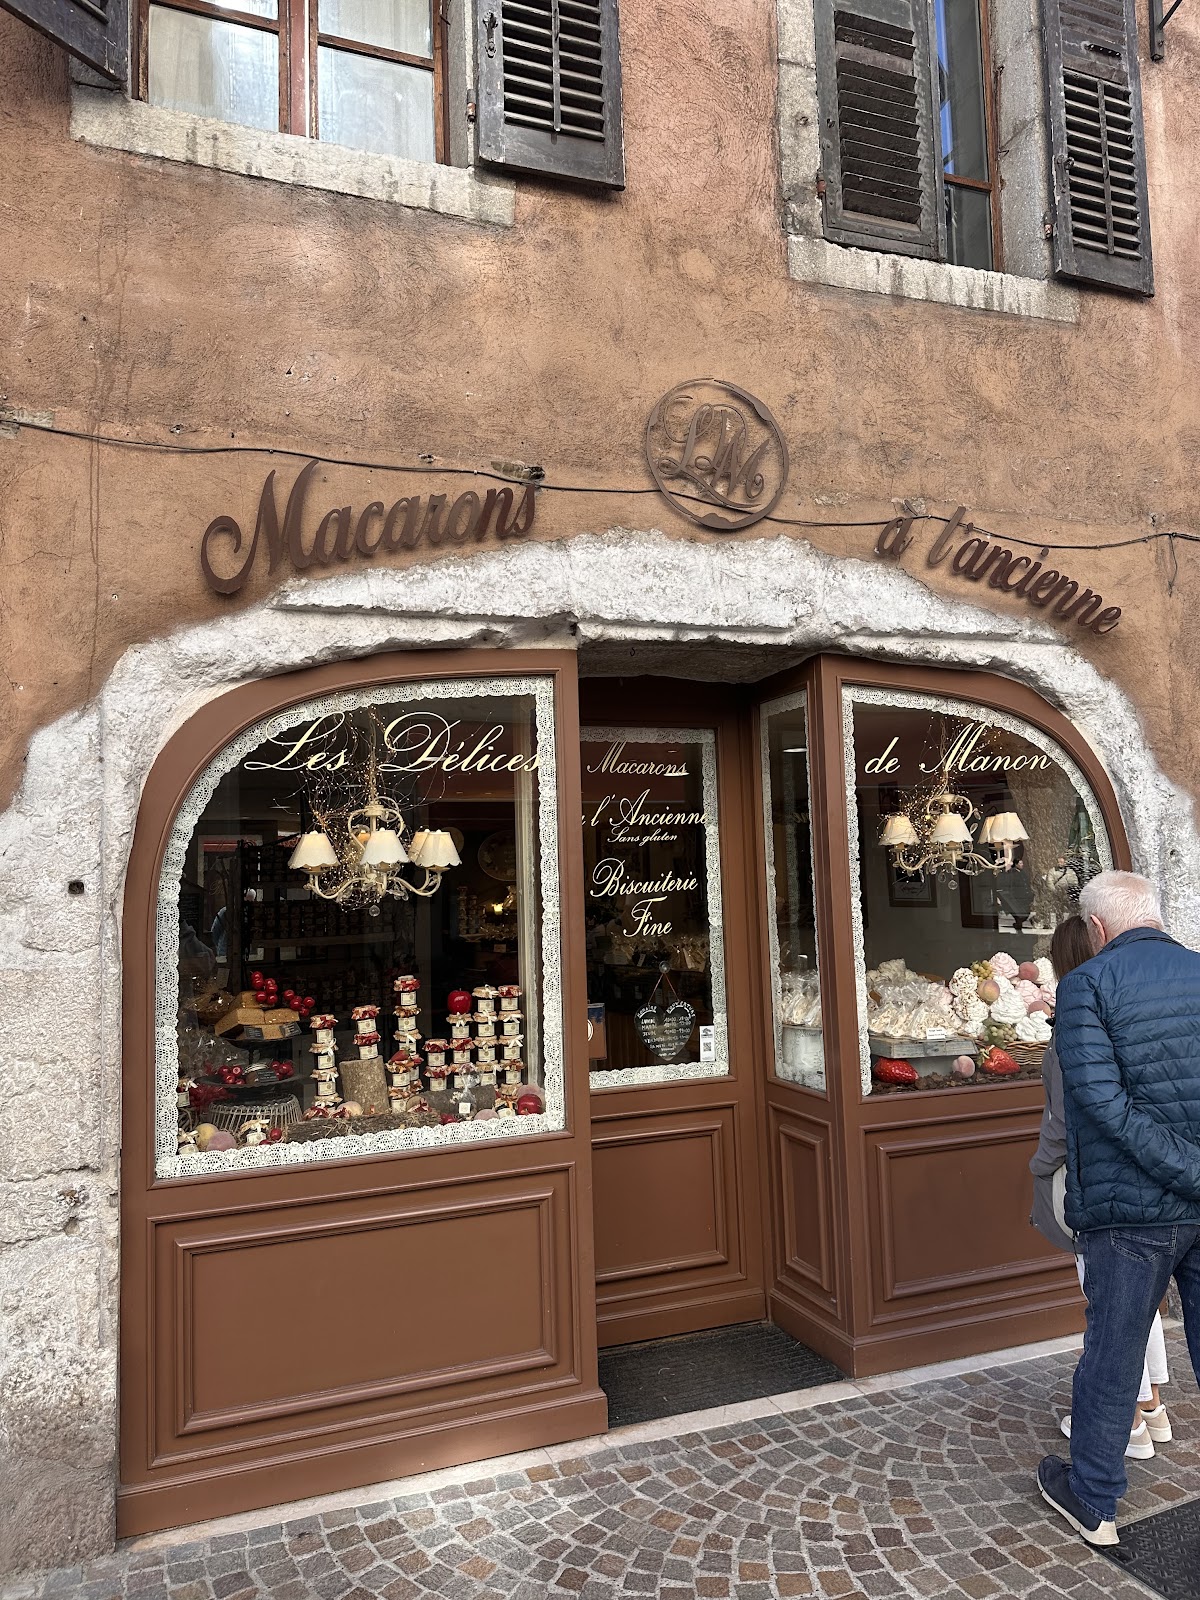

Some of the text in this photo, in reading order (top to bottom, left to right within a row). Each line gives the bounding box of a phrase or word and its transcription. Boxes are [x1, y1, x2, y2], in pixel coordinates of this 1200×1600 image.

[201, 460, 537, 594] Macarons
[877, 499, 1122, 635] à l'ancienne
[244, 710, 541, 773] Les Délices
[586, 740, 688, 775] Macarons
[864, 722, 1051, 774] de Manon
[607, 825, 678, 847] Sans gluten
[589, 857, 699, 897] Biscuiterie
[622, 895, 673, 938] Fine
